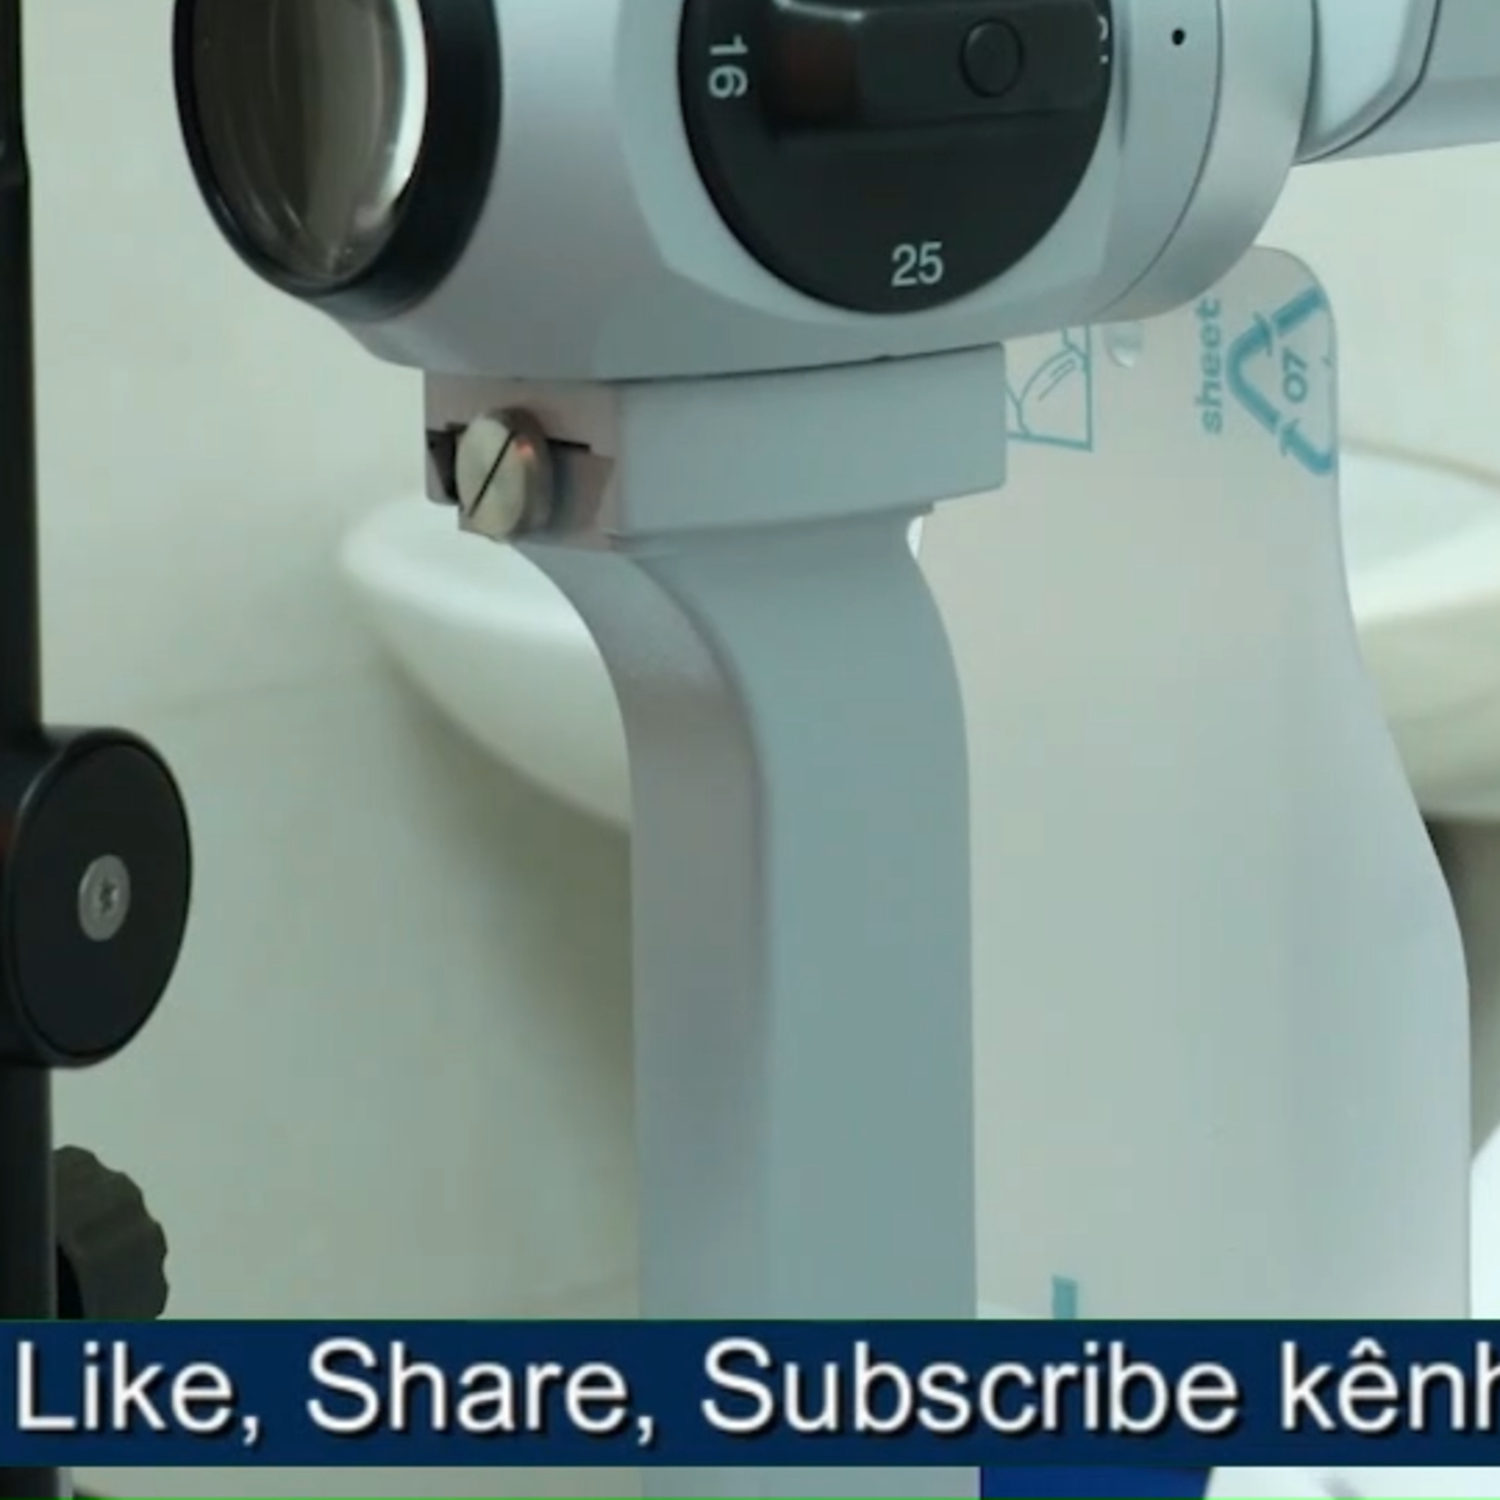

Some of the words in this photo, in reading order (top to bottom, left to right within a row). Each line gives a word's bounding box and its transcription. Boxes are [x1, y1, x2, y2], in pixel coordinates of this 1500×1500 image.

[708, 35, 748, 99] 16
[891, 241, 944, 287] 25
[1195, 297, 1222, 435] sheet
[1282, 347, 1308, 403] 07
